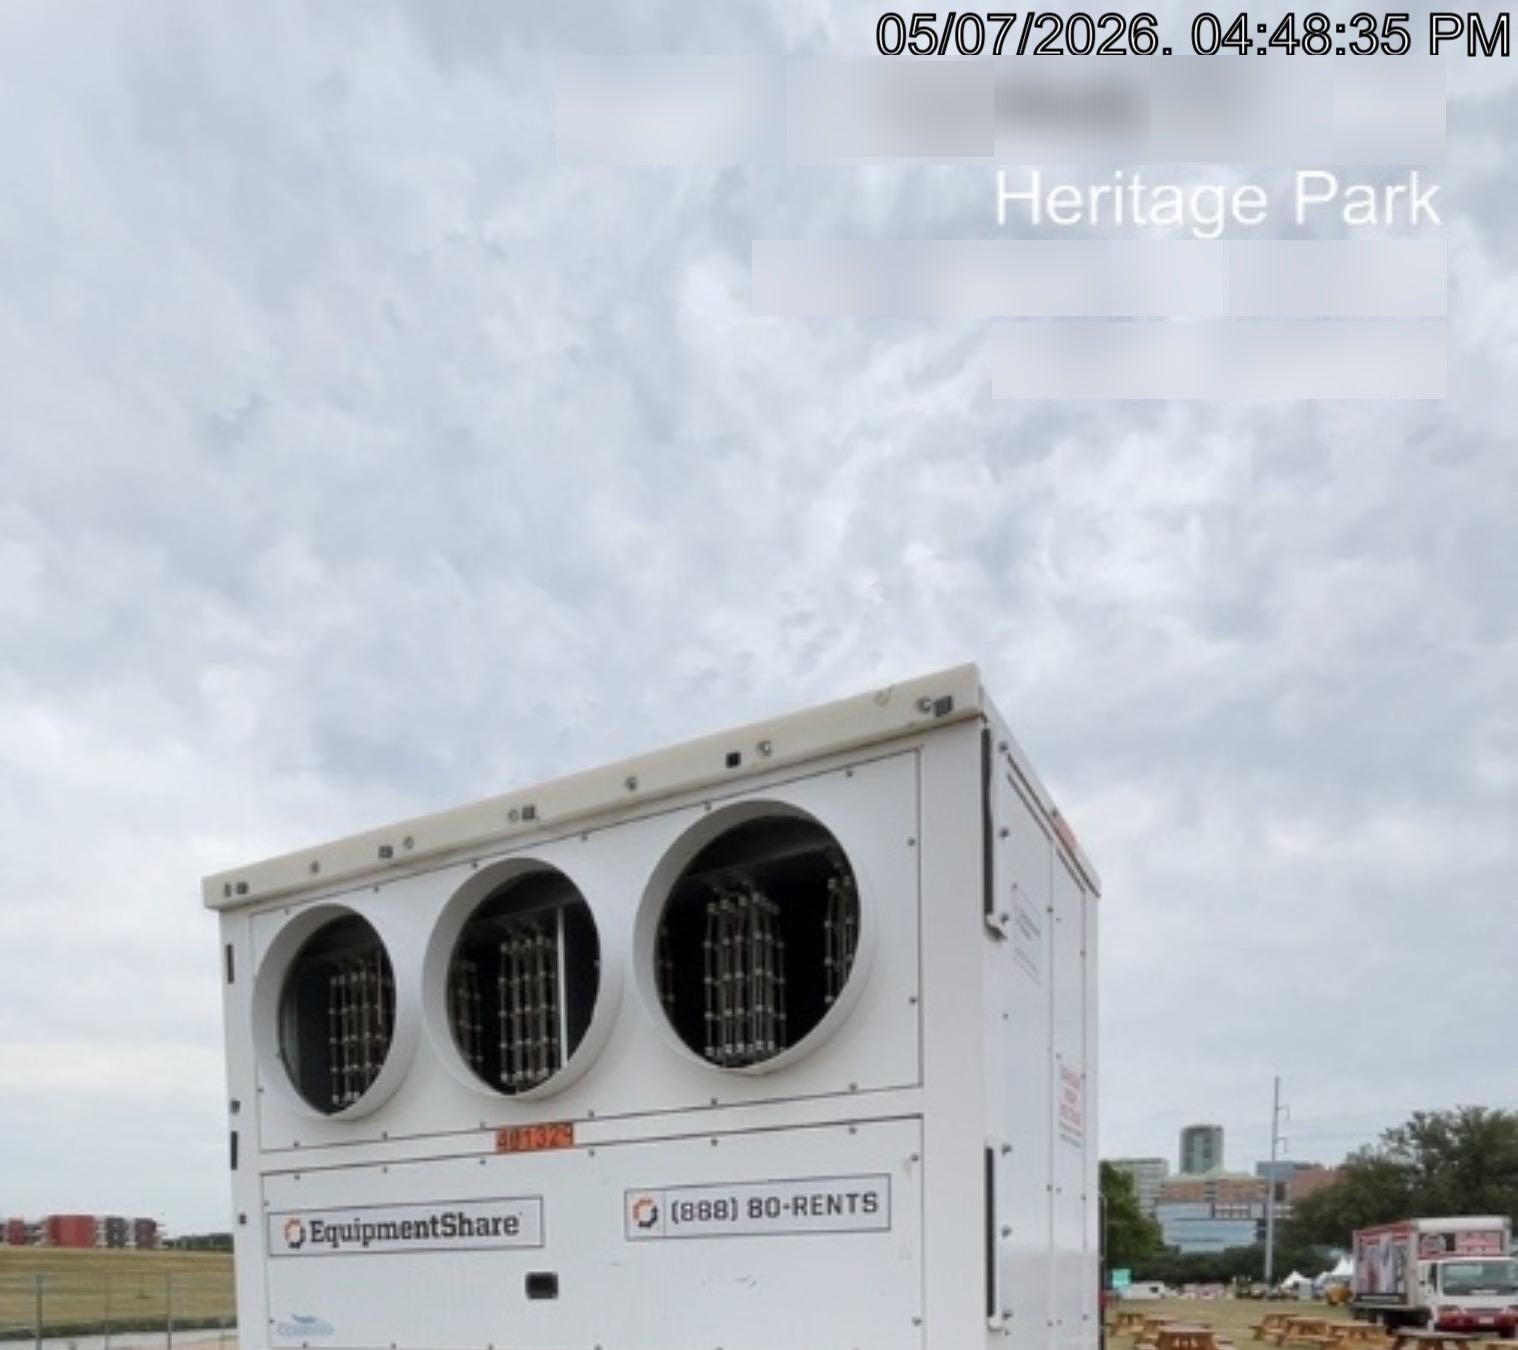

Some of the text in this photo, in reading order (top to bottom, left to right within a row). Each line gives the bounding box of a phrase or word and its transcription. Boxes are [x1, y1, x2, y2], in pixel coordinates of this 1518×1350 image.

[671, 1191, 879, 1225] (888) 80-RENTS
[308, 1211, 520, 1248] EquipmentShare
